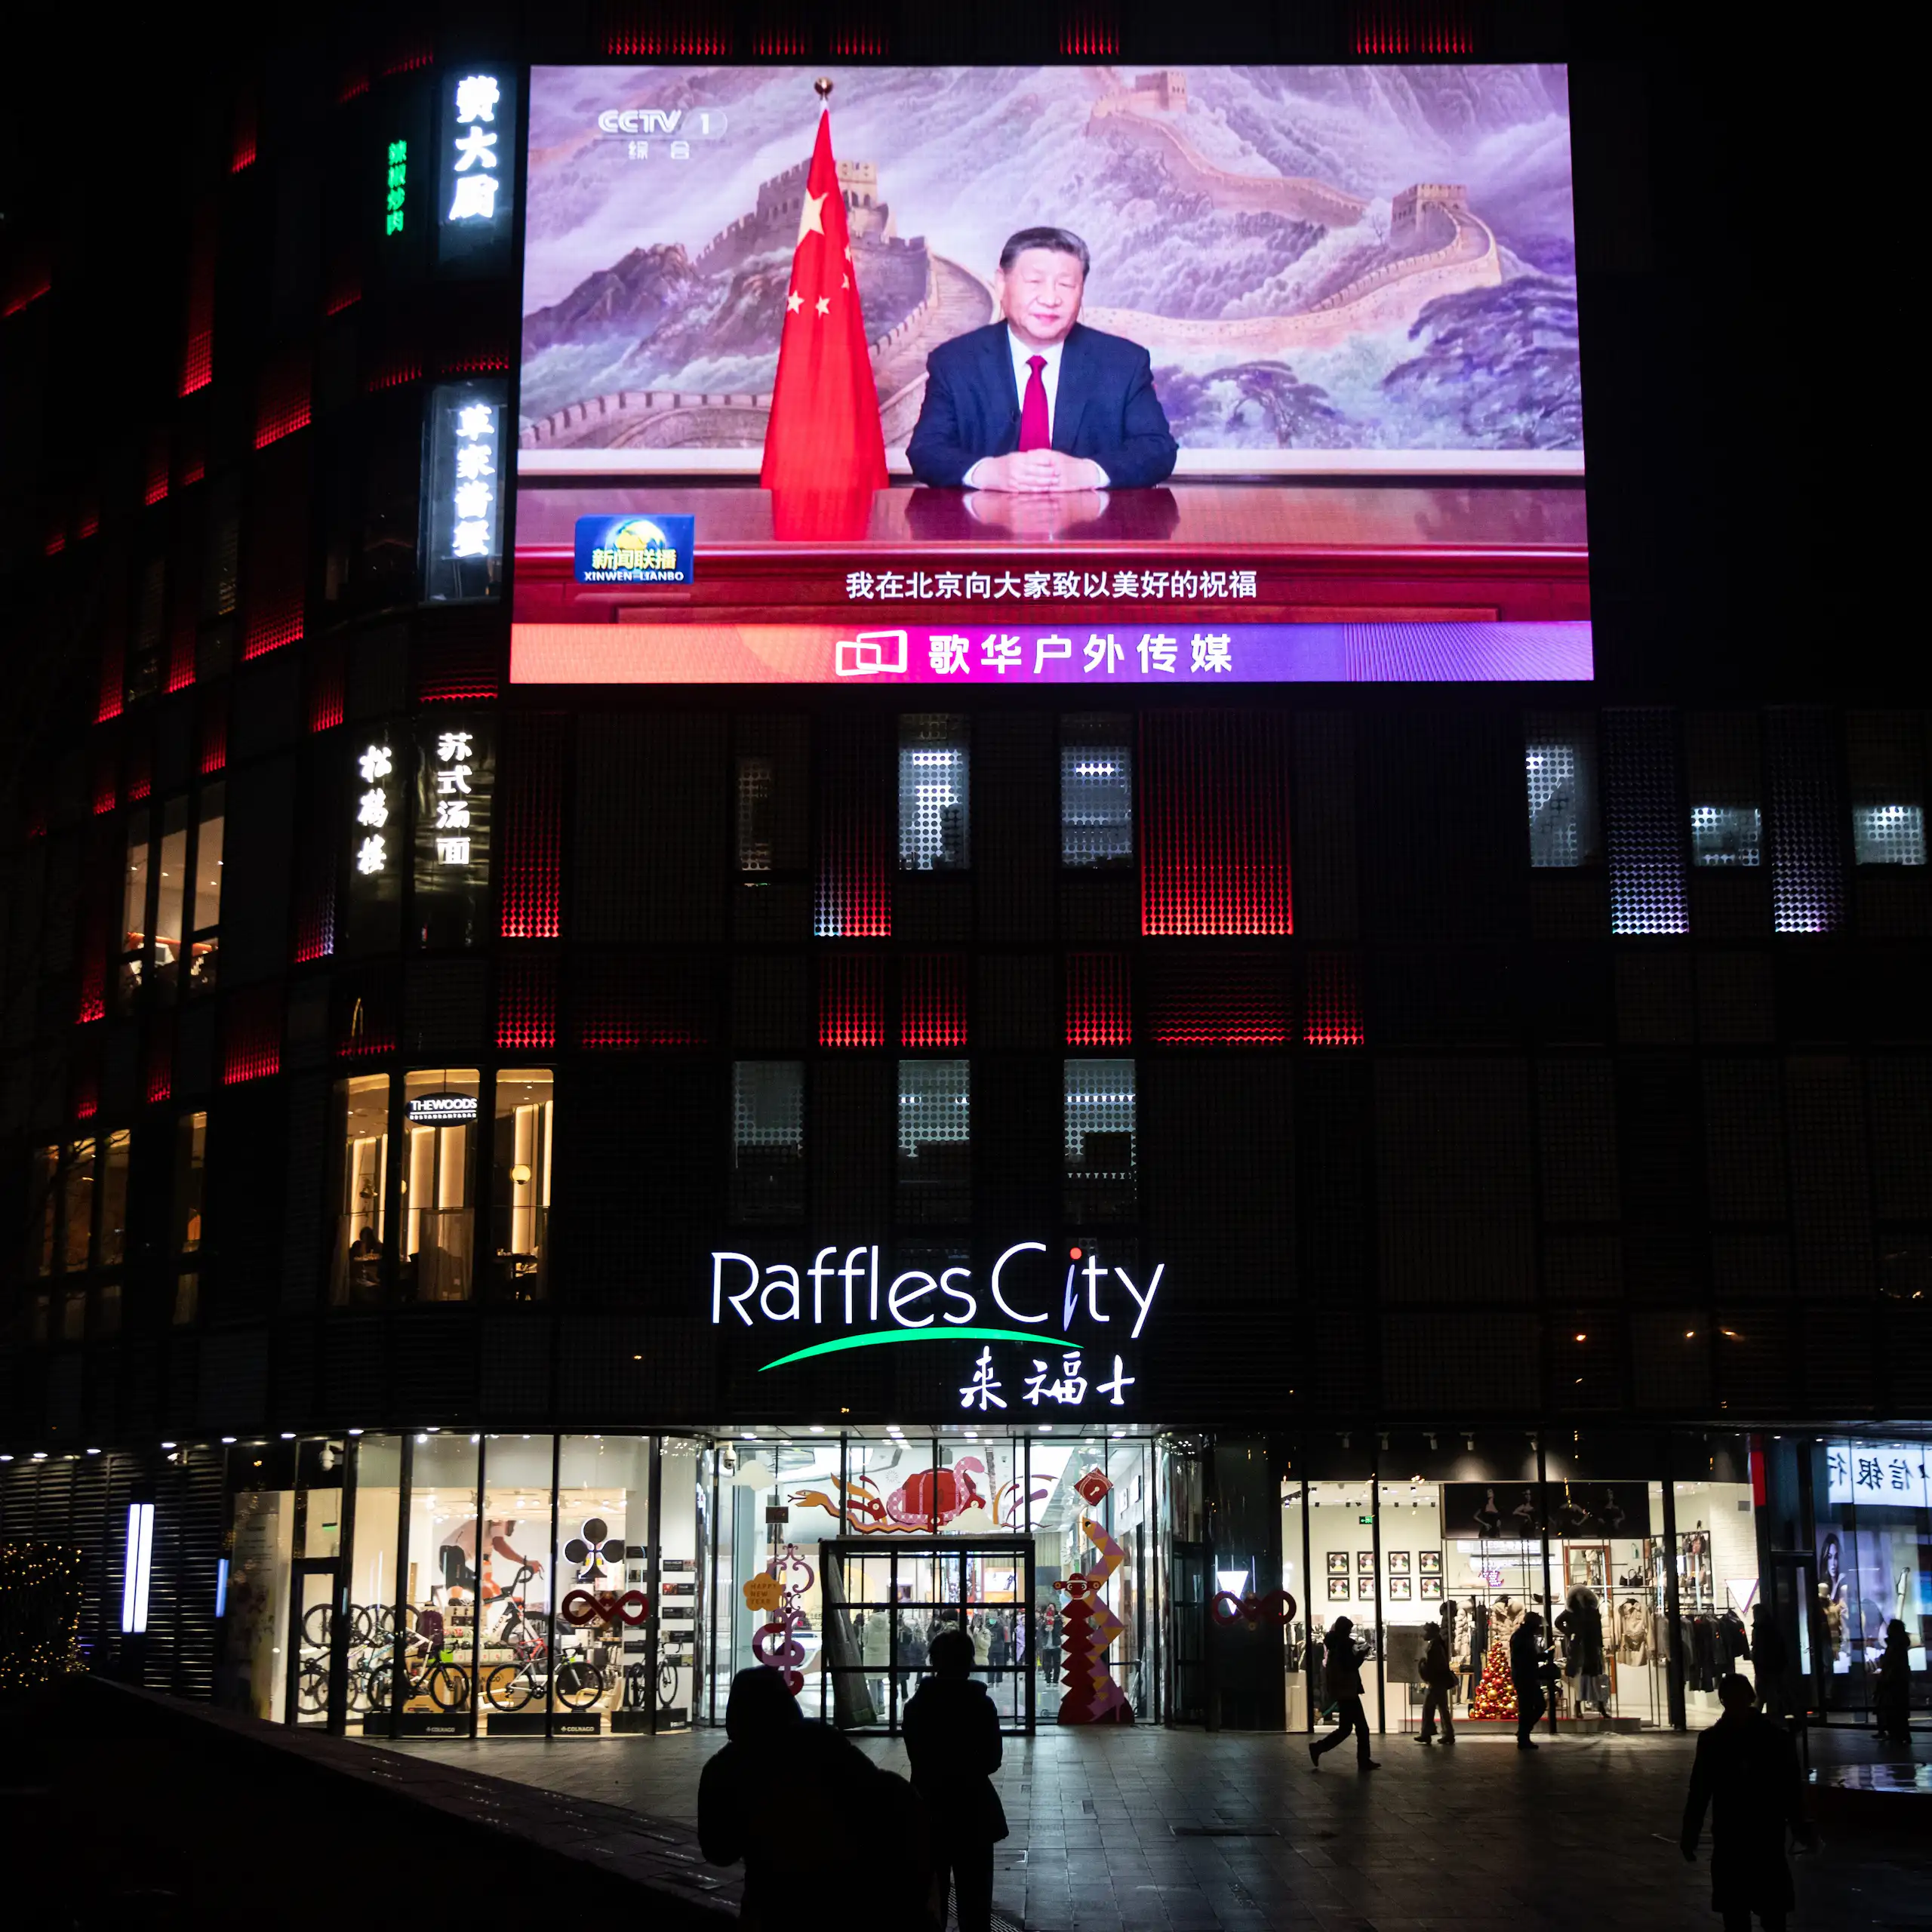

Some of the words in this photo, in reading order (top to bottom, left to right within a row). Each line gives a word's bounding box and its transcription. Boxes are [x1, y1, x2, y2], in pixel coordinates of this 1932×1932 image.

[598, 109, 682, 133] CCTV
[700, 112, 711, 135] 1
[628, 140, 691, 161] 综合
[591, 548, 677, 571] 新闻联播
[845, 571, 1257, 599] 我在北京向大家致以美好的祝福
[928, 633, 1233, 674] 歌华户外传媒
[435, 732, 474, 866] 苏式汤面
[711, 1244, 977, 1327] Raffles
[991, 1241, 1165, 1339] City
[959, 1345, 1136, 1411] 来福士
